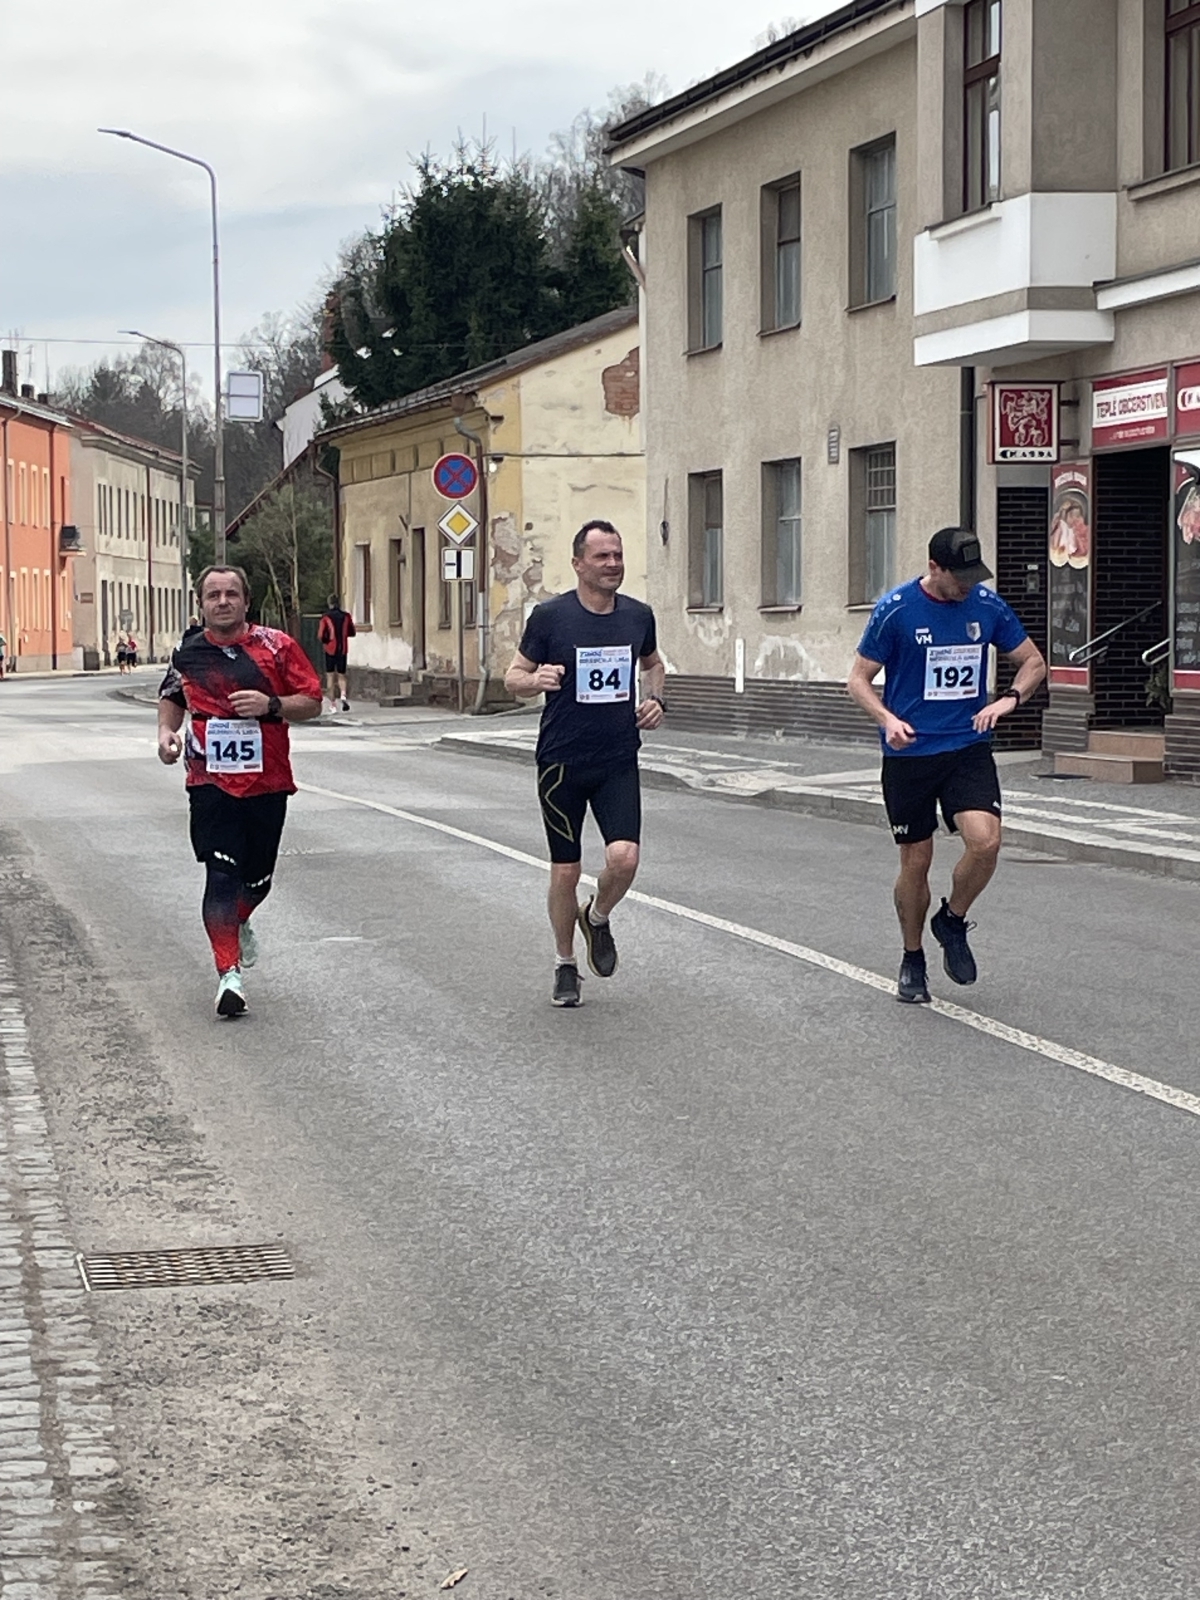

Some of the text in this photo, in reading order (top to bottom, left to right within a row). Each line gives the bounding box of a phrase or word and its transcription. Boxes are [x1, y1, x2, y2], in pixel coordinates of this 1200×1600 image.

[589, 668, 621, 691] 84
[933, 666, 974, 688] 192
[212, 740, 255, 762] 145
